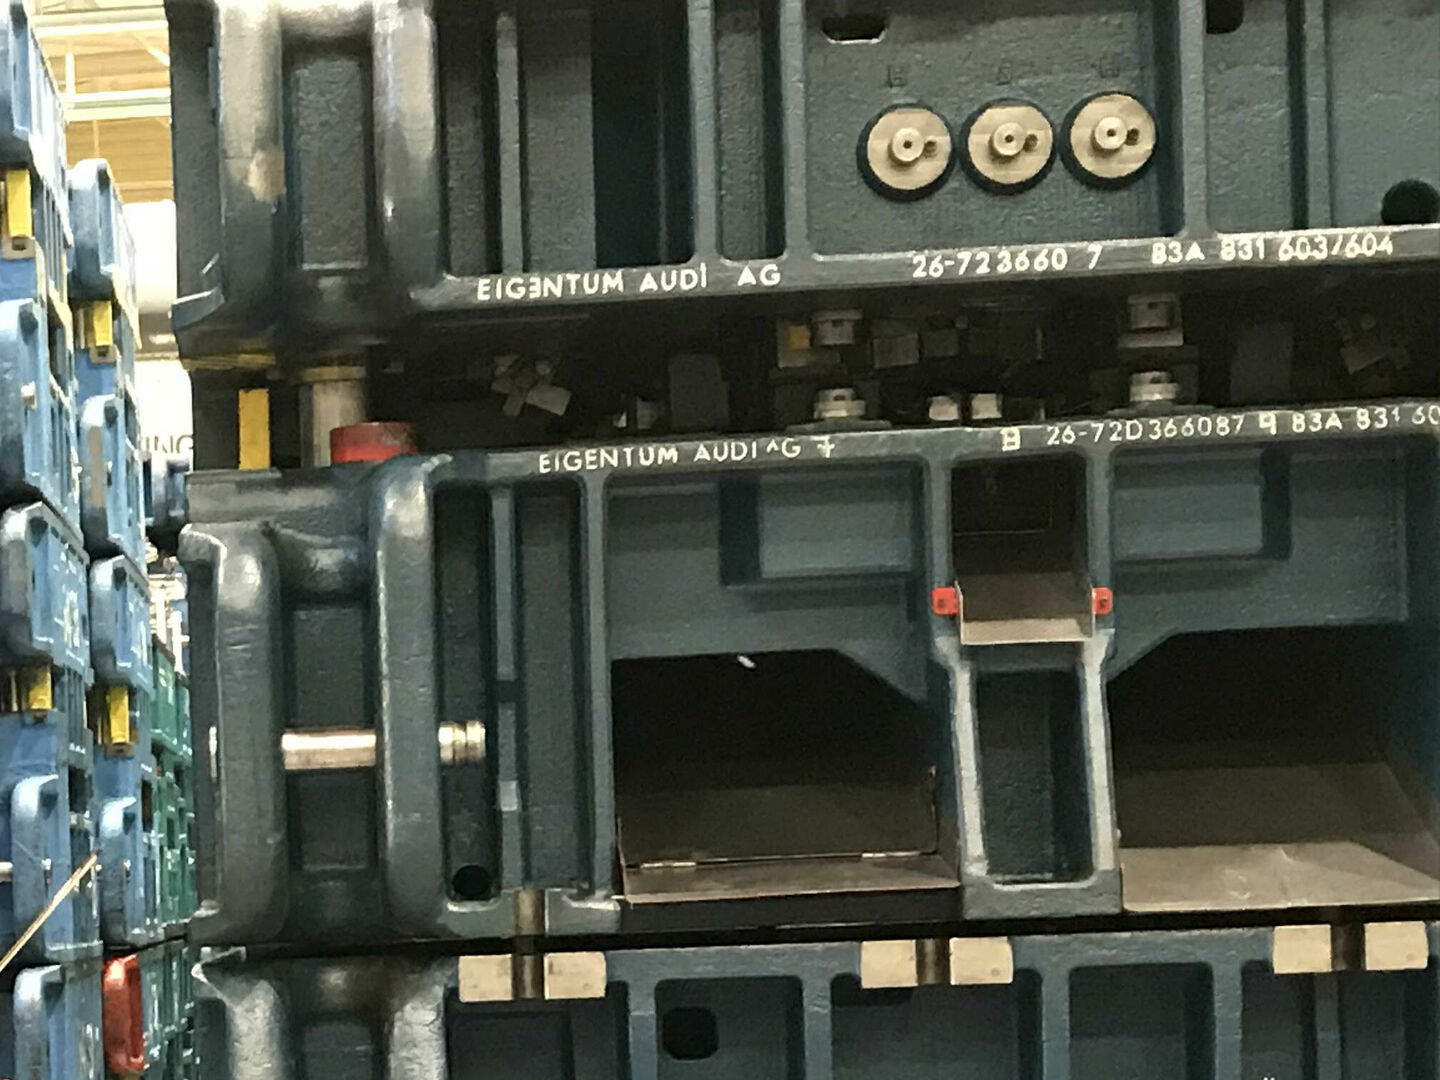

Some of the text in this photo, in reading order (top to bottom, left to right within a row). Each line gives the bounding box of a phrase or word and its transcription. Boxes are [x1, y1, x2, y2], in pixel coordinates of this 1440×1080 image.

[639, 263, 707, 292] AUDI
[737, 264, 781, 286] AG
[1151, 241, 1206, 264] 83A
[538, 446, 678, 474] EIGENTUM
[693, 440, 757, 463] AUDI
[1046, 415, 1245, 446] 26-72D366087
[1291, 411, 1343, 433] 83A
[1356, 406, 1400, 430] 831
